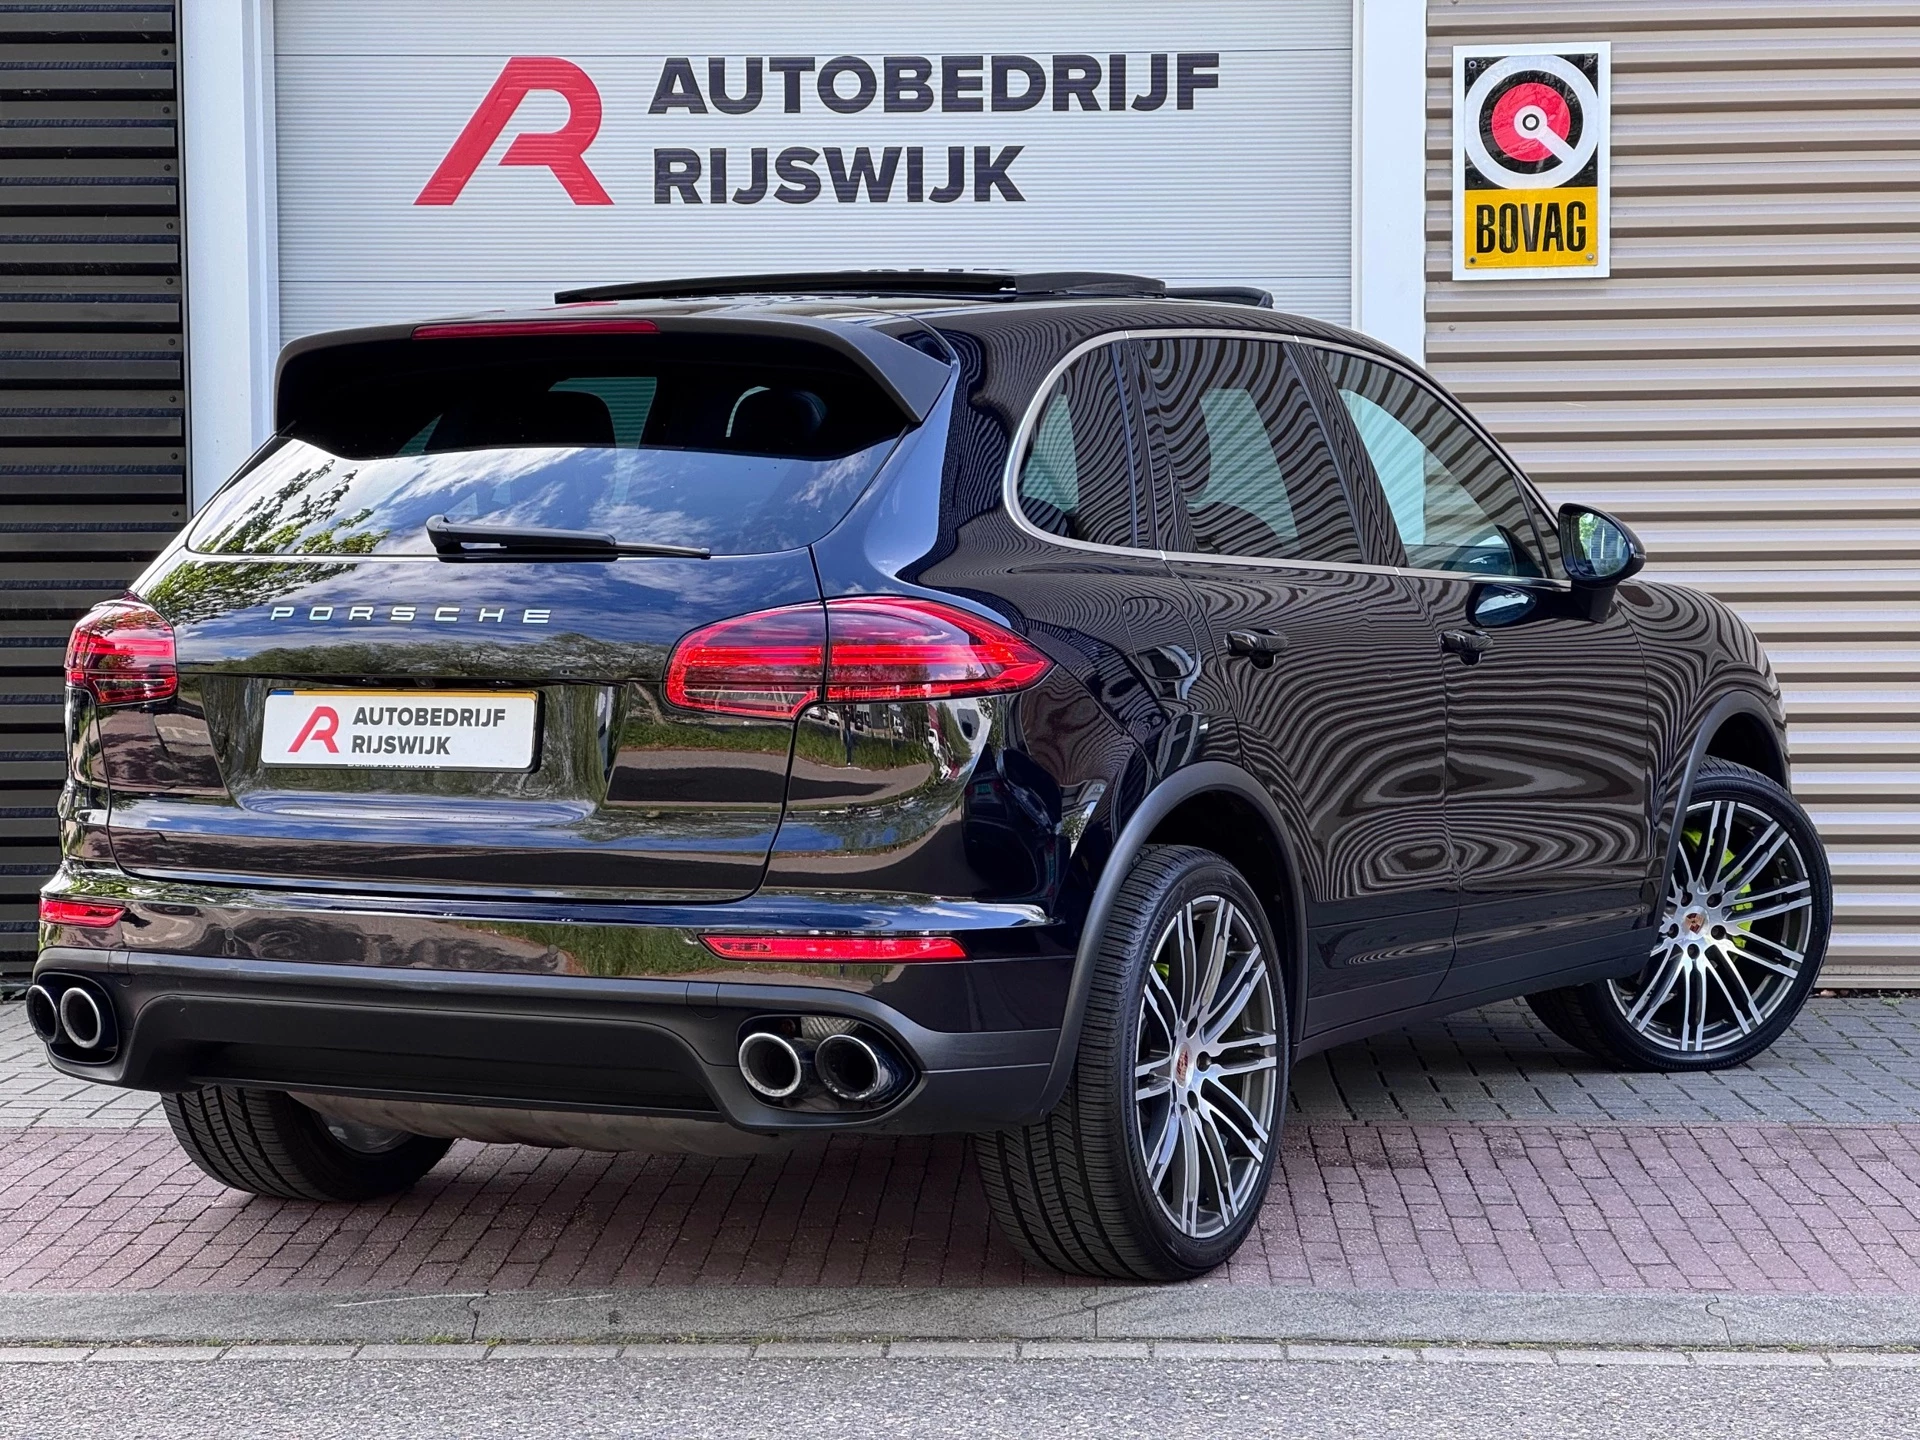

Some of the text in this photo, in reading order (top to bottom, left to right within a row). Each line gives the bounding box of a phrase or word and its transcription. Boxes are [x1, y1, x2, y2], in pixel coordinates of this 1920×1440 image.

[648, 52, 1219, 115] AUTOBEDRIJF
[653, 145, 1026, 205] RIJSWIJK
[1476, 201, 1587, 254] BOVAG
[270, 606, 552, 624] PORSCHE
[352, 706, 506, 727] AUTOBEDRIJF
[351, 735, 451, 755] RIJSWIJK
